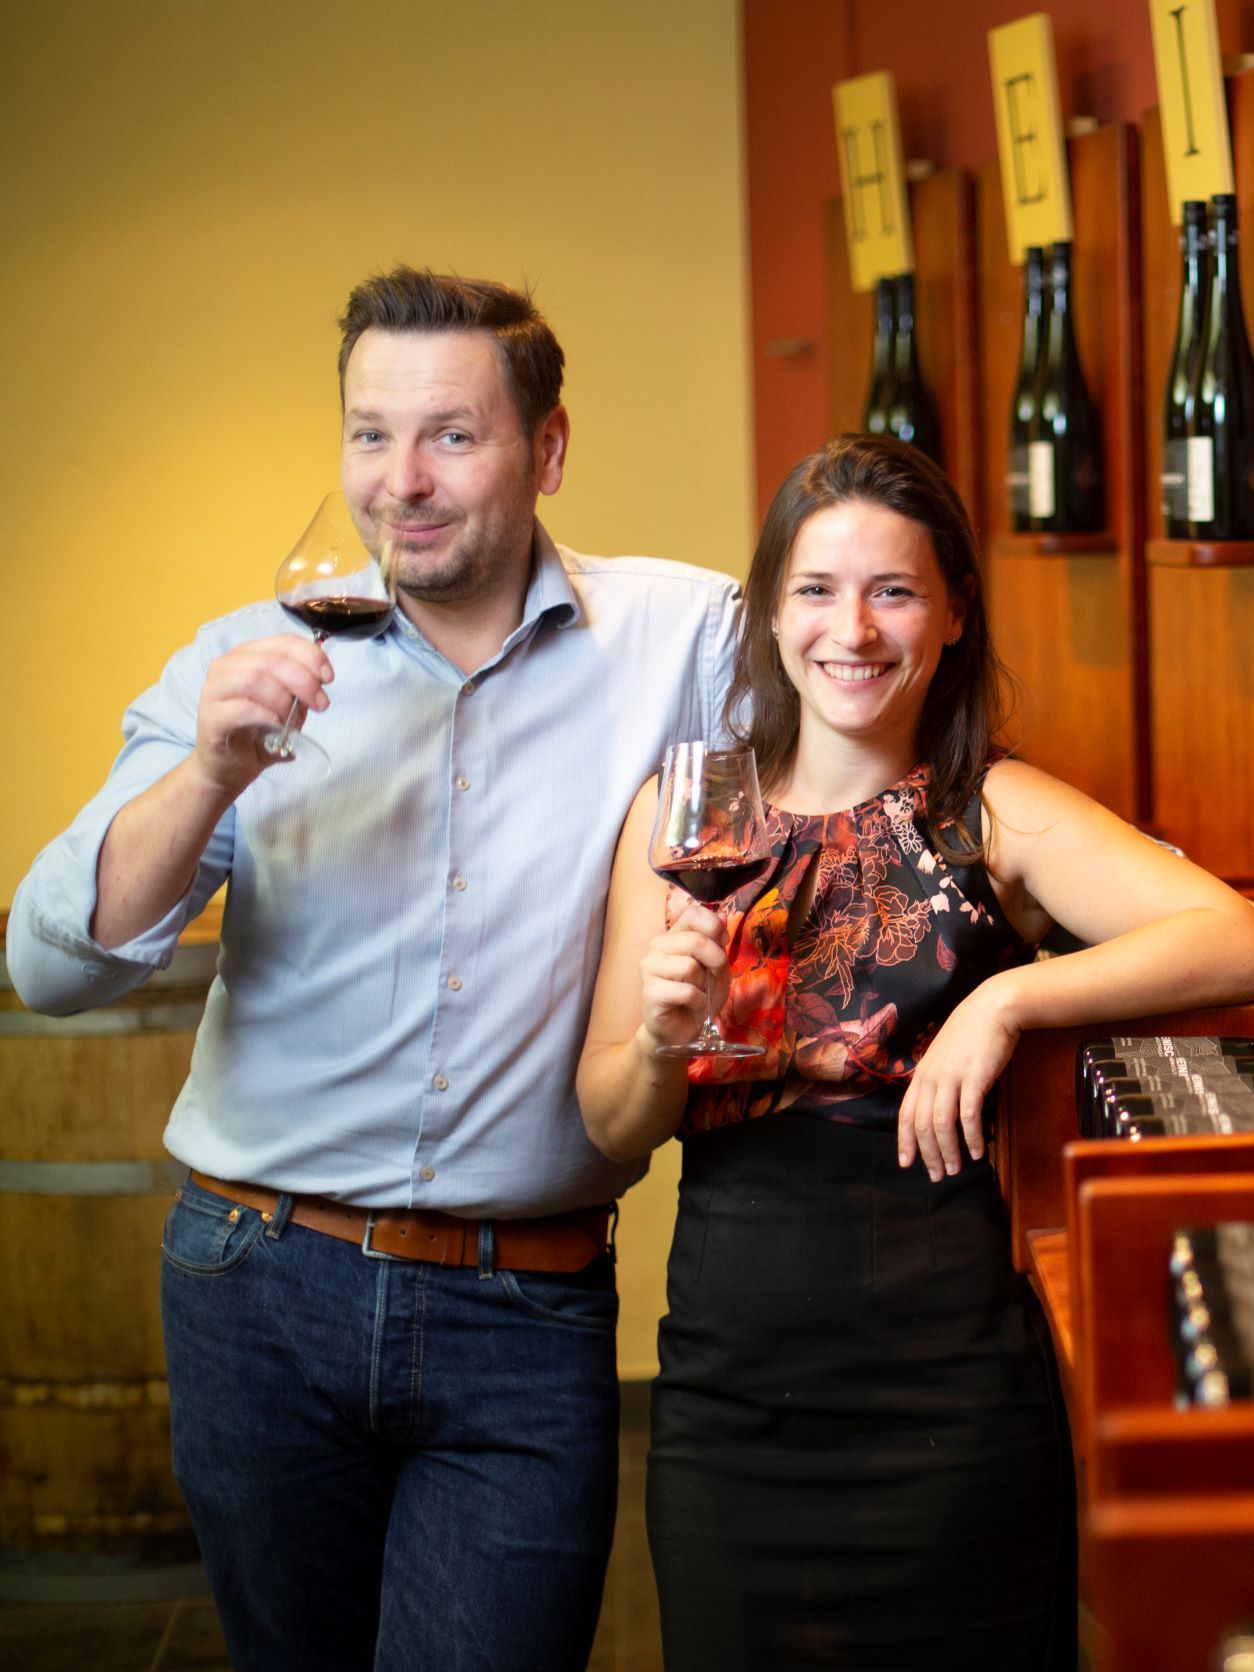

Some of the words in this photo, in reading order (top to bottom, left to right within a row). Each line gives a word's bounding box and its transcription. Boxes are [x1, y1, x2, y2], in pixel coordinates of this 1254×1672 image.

[843, 119, 897, 240] H
[1005, 71, 1047, 205] E
[1169, 5, 1200, 157] I
